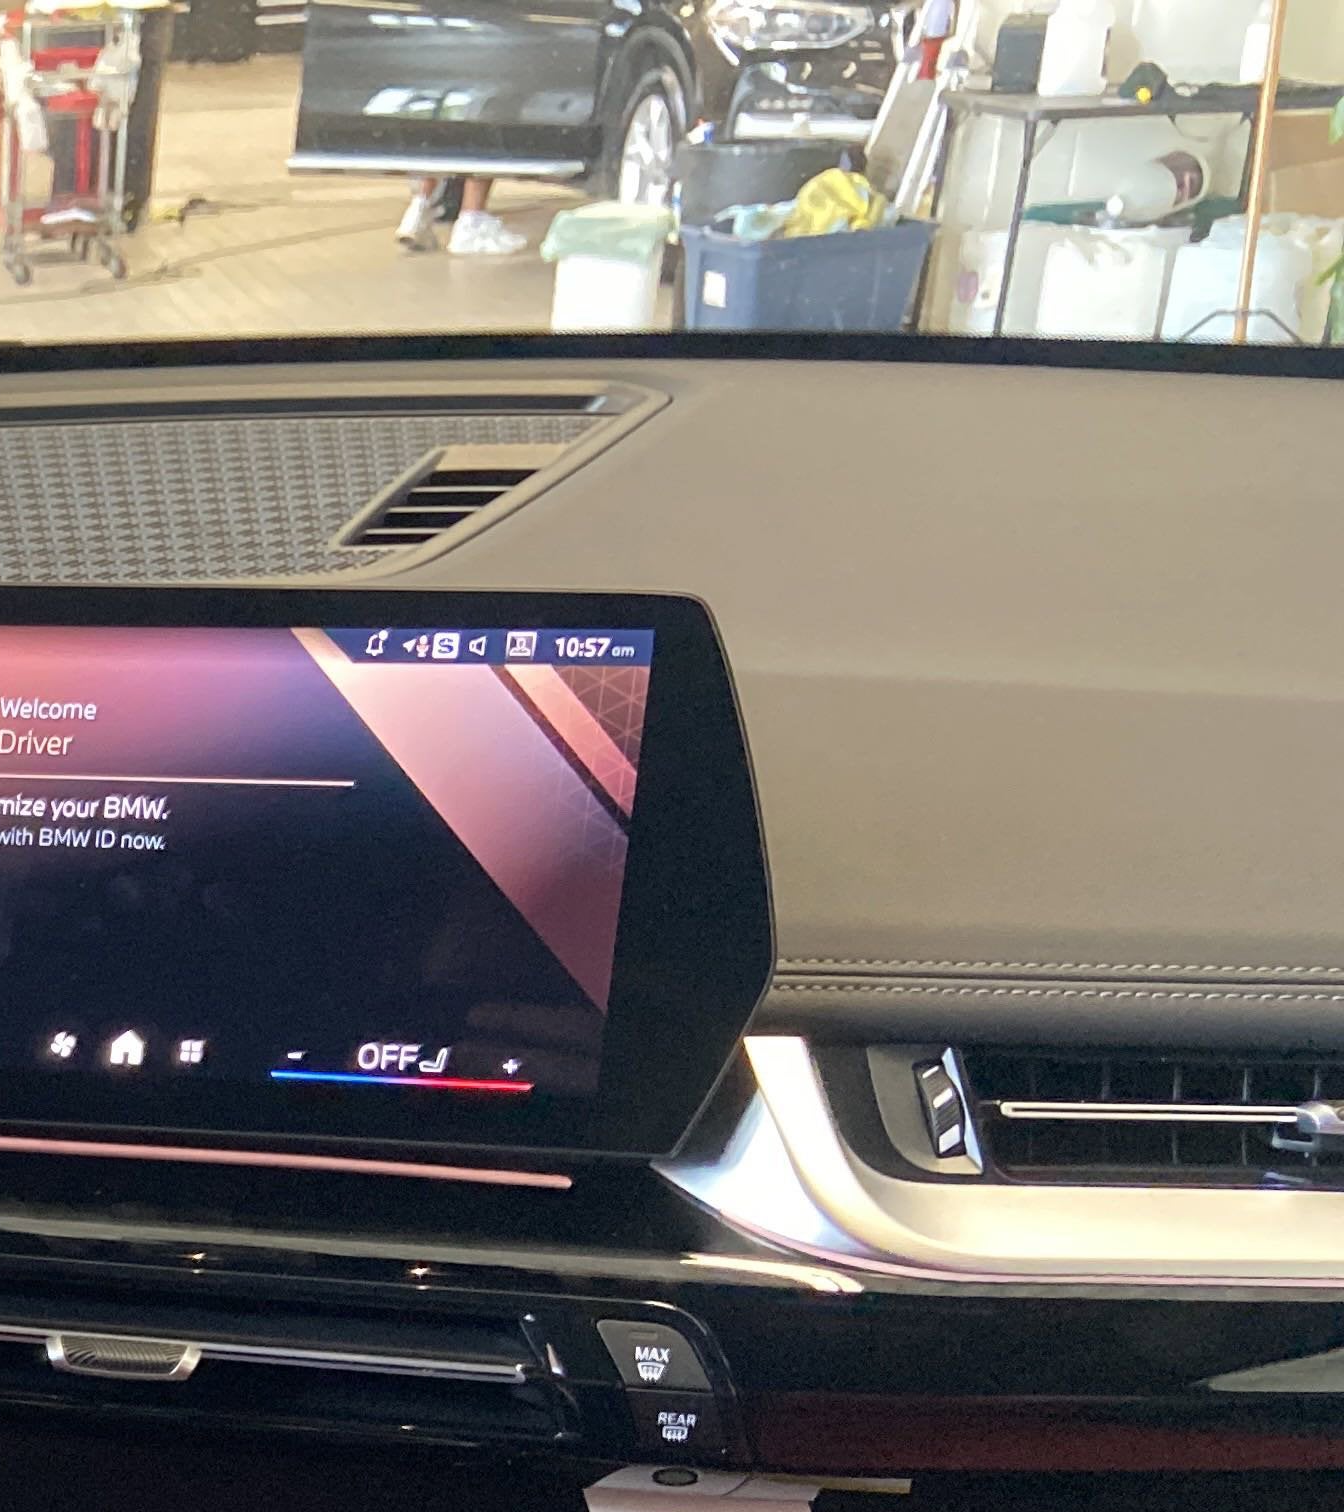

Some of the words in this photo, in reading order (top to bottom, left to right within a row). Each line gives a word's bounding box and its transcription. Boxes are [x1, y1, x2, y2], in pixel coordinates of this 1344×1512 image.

[555, 637, 611, 658] 10:57
[612, 645, 635, 658] am
[0, 697, 97, 720] Welcome
[51, 799, 99, 820] your
[103, 796, 169, 820] BMW.
[39, 828, 90, 848] BMW
[96, 829, 115, 848] ID
[121, 832, 166, 850] now.
[357, 1043, 420, 1070] OFF
[635, 1346, 670, 1363] MAX
[657, 1412, 696, 1428] REAR
